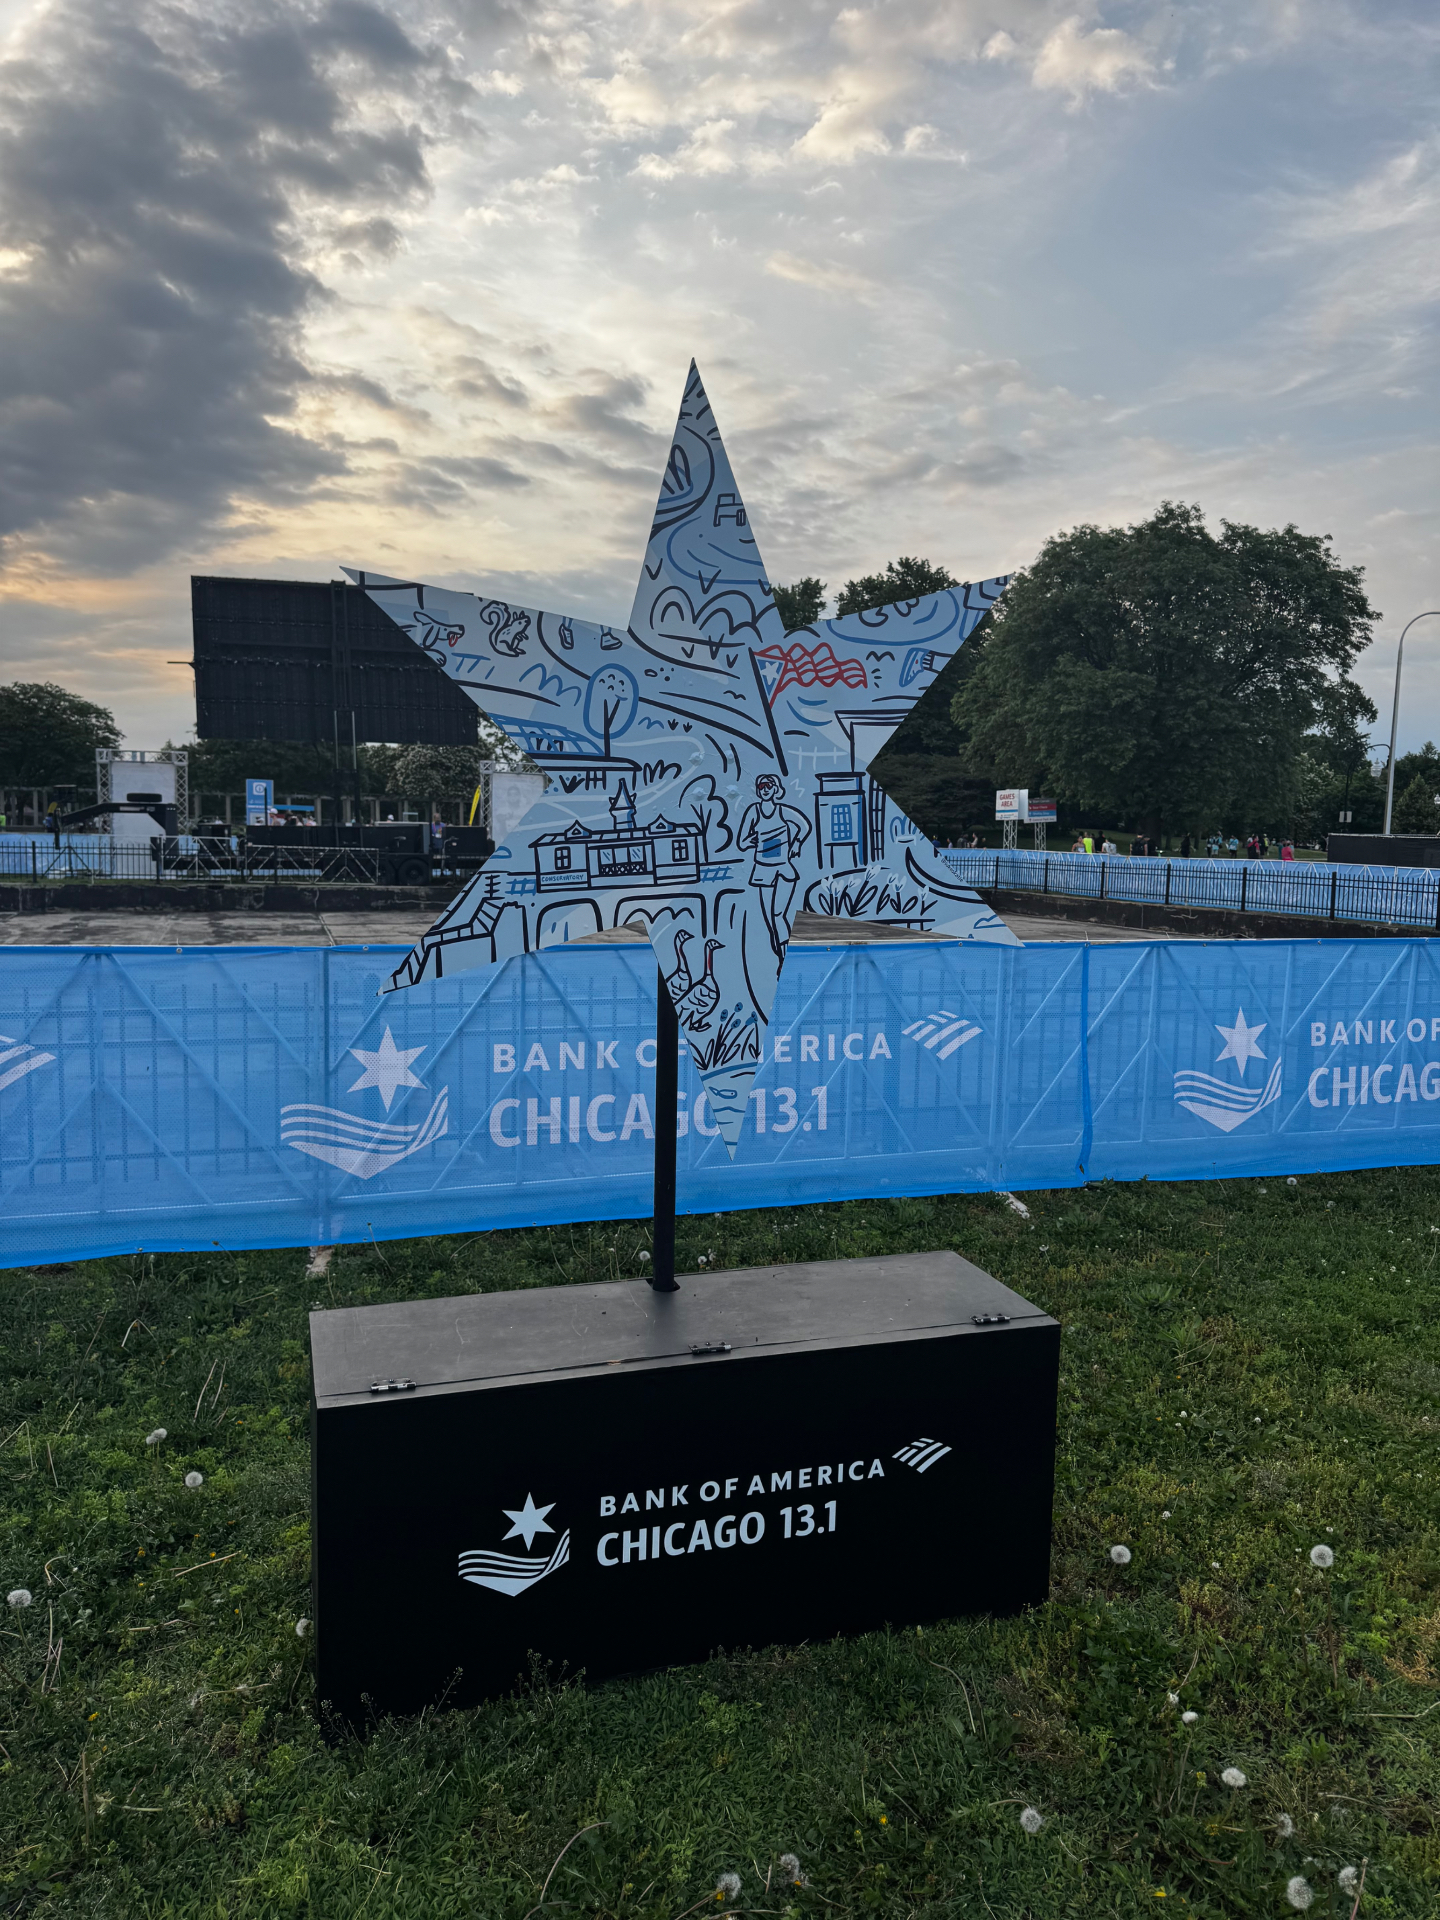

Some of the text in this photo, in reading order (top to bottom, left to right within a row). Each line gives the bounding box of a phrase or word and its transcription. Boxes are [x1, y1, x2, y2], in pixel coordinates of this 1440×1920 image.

[541, 874, 584, 882] CONSERVATORY
[493, 1041, 620, 1073] BANK
[758, 1032, 893, 1064] ERICA
[1310, 1017, 1440, 1047] BANK OF
[1308, 1061, 1440, 1108] CHICAG
[749, 1085, 828, 1134] 13.1
[600, 1458, 886, 1517] BANK OF AMERICA
[596, 1500, 838, 1567] CHICAGO 13.1
